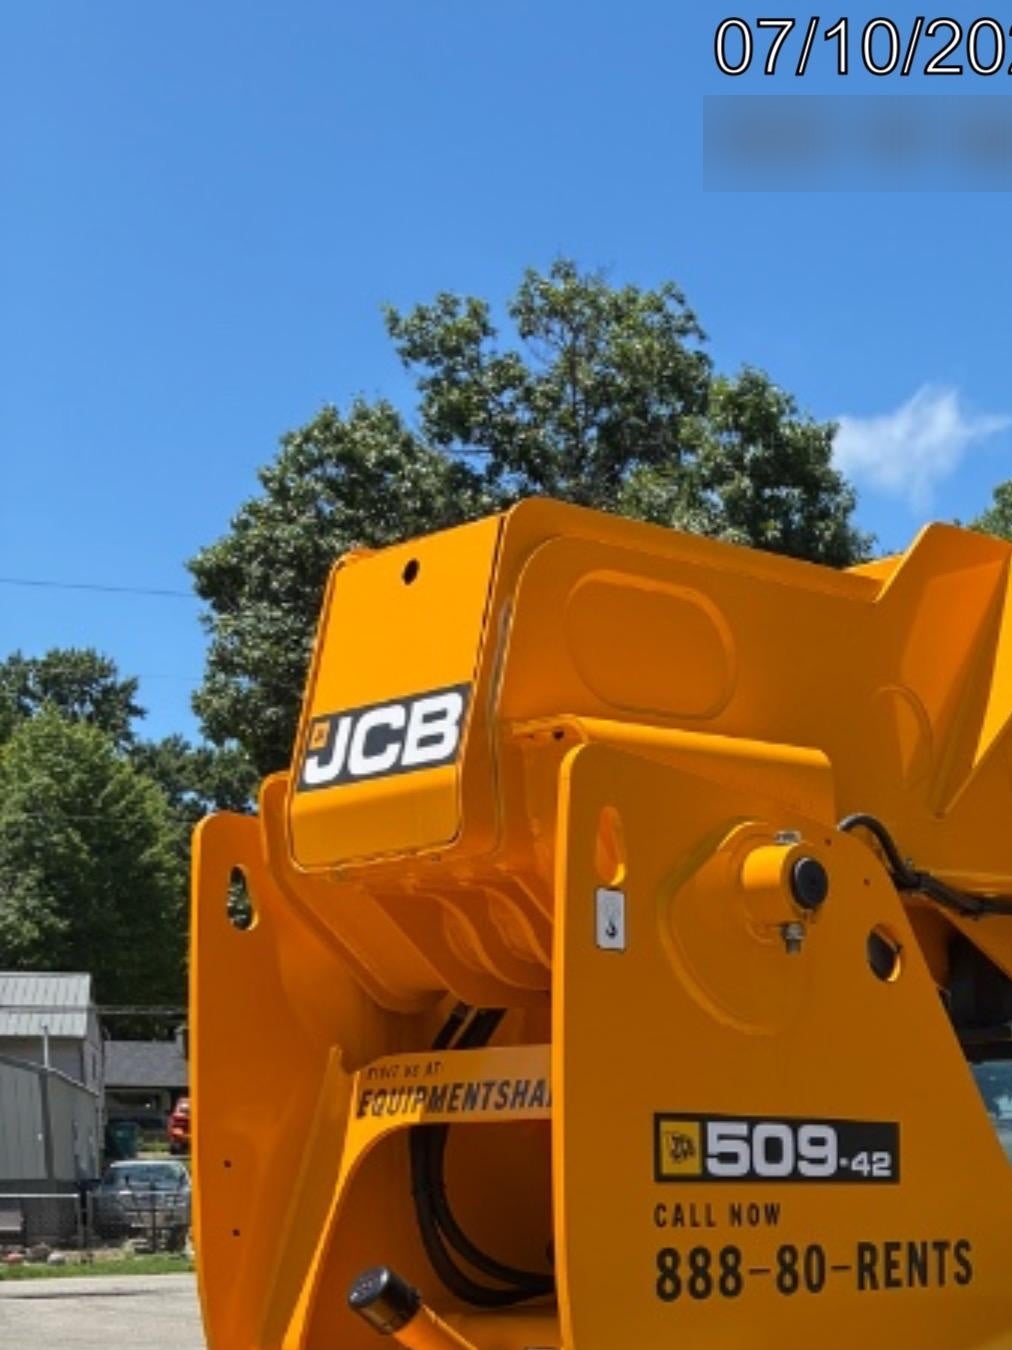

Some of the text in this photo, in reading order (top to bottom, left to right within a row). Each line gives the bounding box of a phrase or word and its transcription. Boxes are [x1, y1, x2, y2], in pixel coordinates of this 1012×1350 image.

[303, 692, 463, 784] JCB
[357, 1077, 552, 1119] EQUIPMENTSHA
[654, 1202, 781, 1227] CALL NOW
[655, 1239, 973, 1302] 888-80-RENTS
